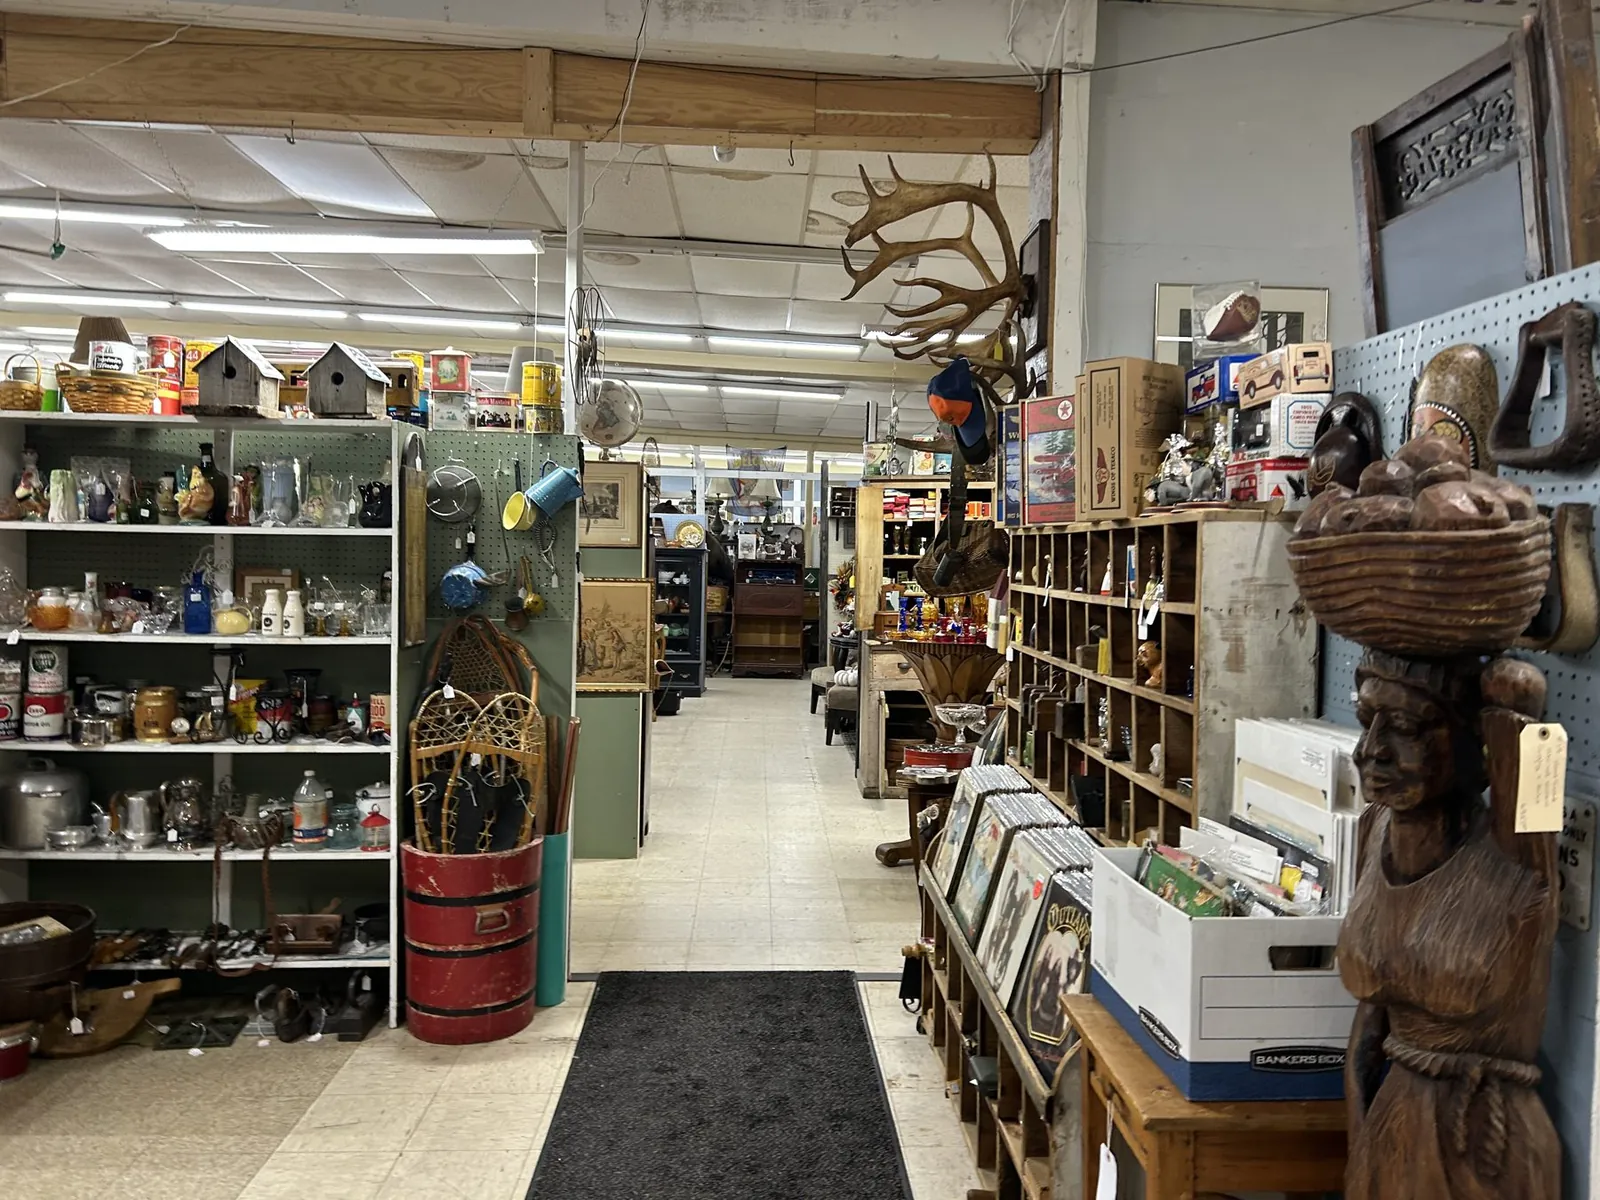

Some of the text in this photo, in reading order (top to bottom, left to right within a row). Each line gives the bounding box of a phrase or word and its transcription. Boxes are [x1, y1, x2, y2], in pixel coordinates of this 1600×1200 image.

[186, 350, 199, 361] 44
[1256, 1054, 1345, 1065] BANKERS BOX
